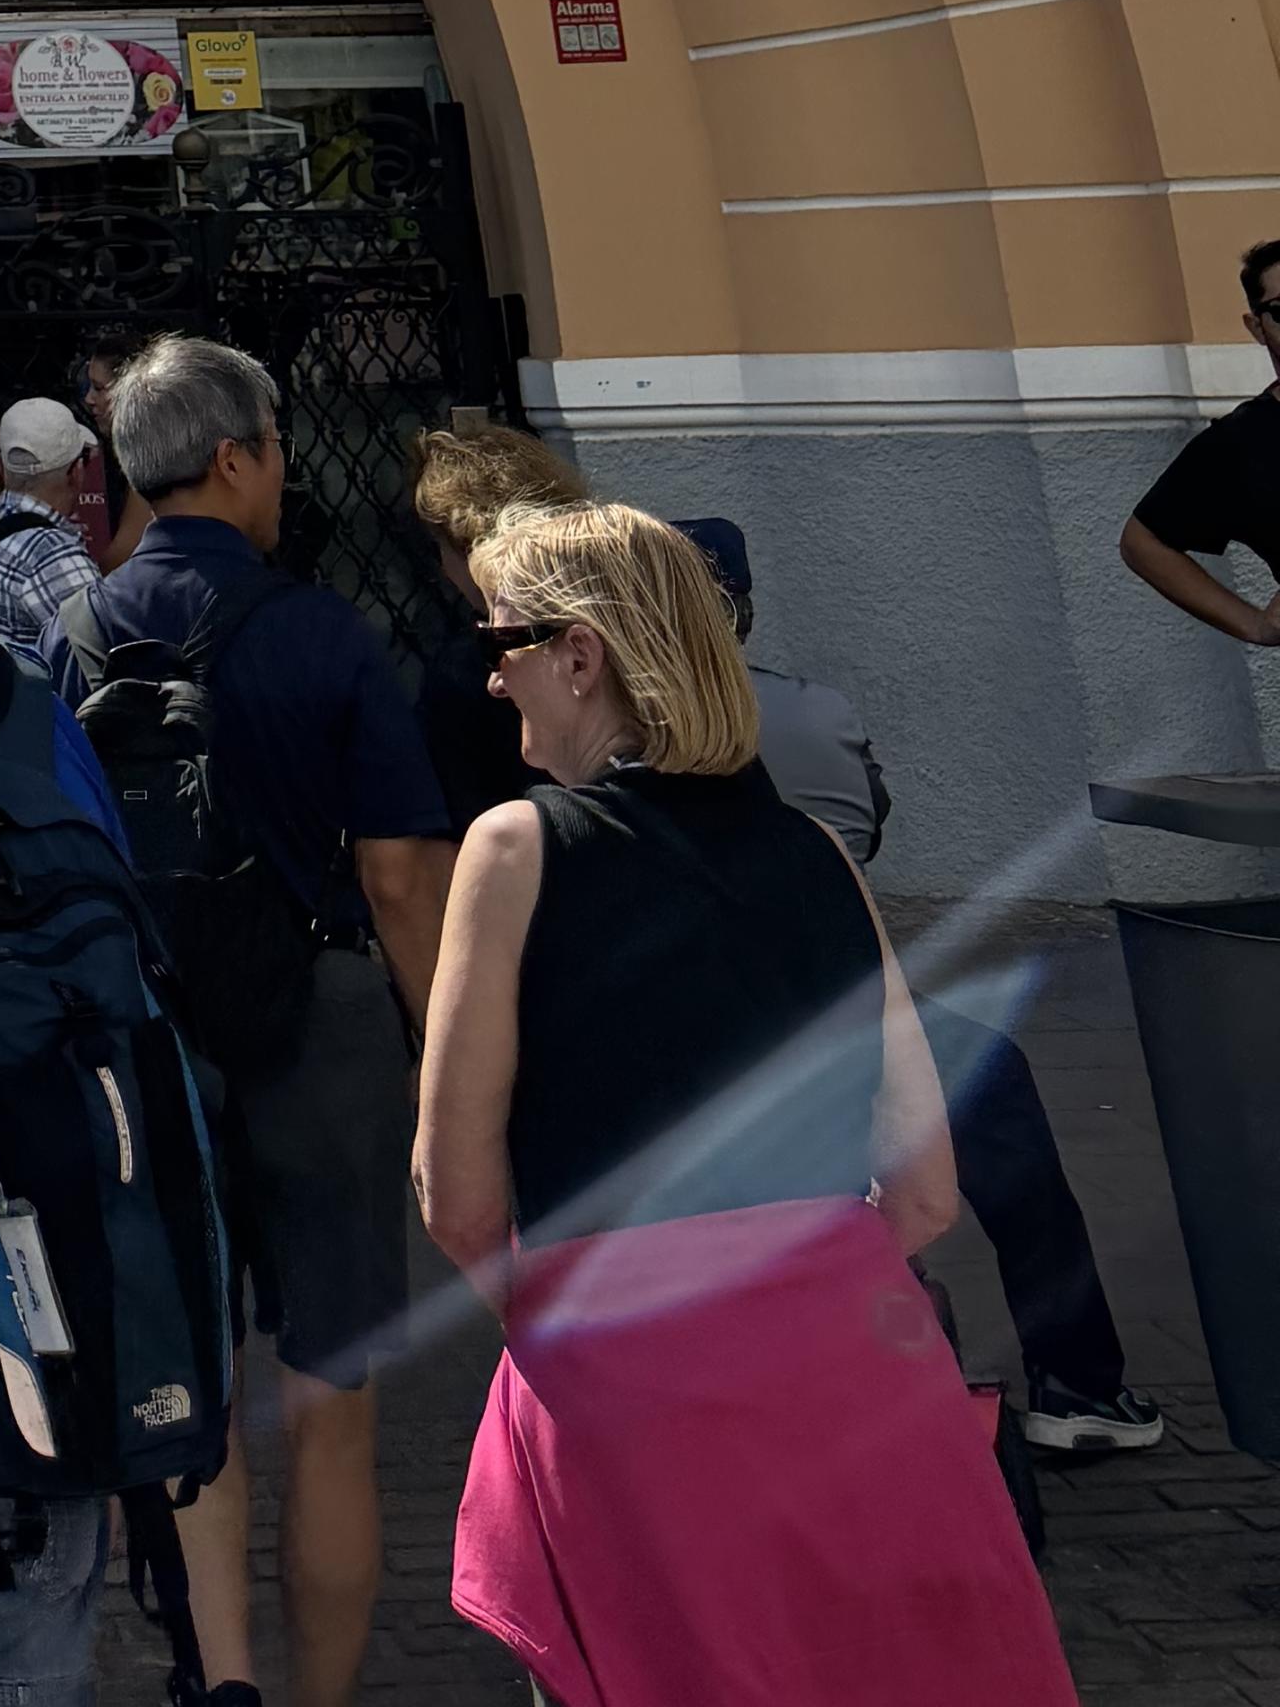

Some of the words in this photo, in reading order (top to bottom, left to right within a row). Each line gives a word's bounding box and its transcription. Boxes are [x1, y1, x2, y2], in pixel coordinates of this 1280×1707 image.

[557, 1, 615, 16] Alarma
[195, 38, 241, 52] Glovo
[20, 67, 60, 82] home
[62, 67, 74, 82] &
[78, 66, 129, 82] flowers
[19, 93, 65, 104] ENTREGA
[68, 94, 75, 103] A
[150, 1386, 172, 1401] THE
[143, 1409, 172, 1428] FACE
